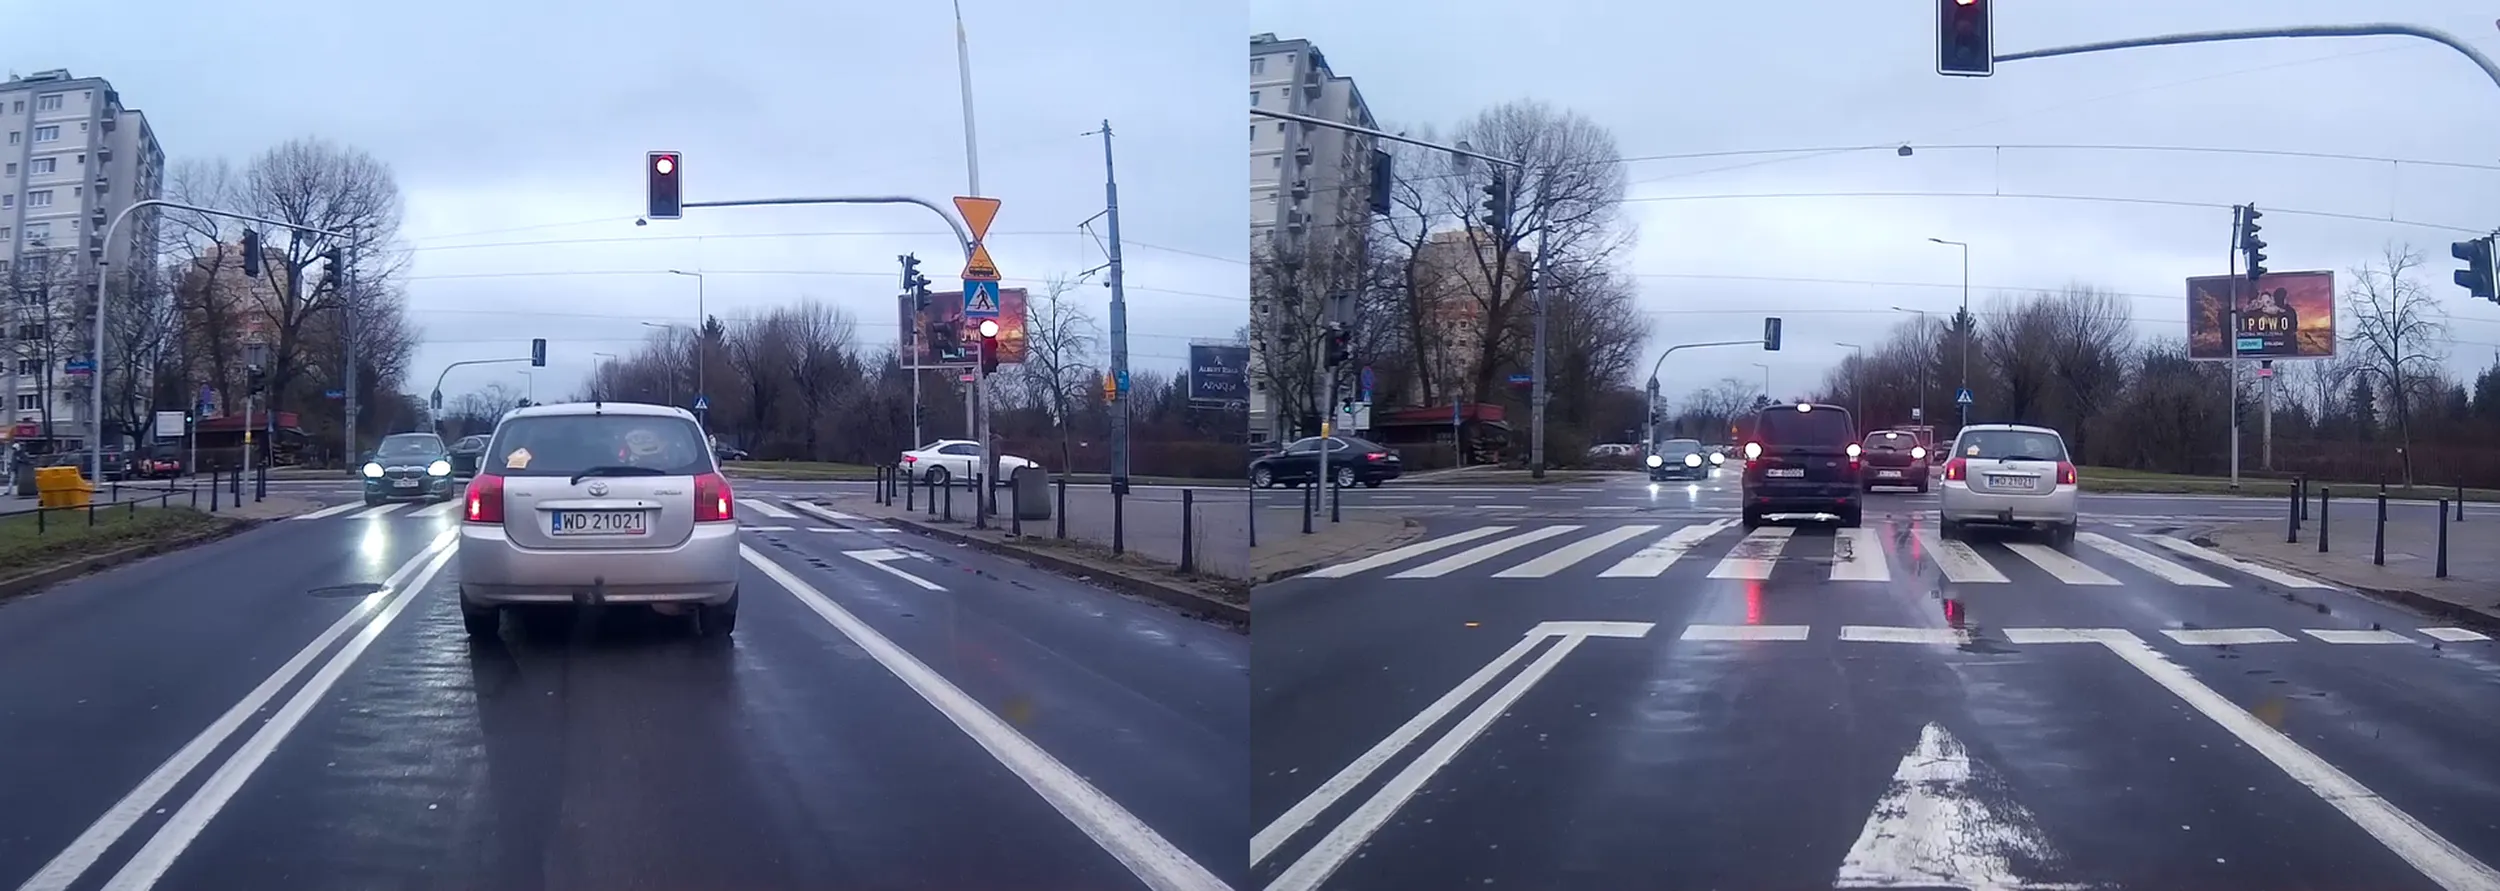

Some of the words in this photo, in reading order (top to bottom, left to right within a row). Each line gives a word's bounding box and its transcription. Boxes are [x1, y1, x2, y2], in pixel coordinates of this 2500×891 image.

[2235, 317, 2288, 331] IPOWO
[2008, 477, 2032, 486] 21021
[563, 513, 587, 530] WD
[592, 513, 641, 529] 21021
